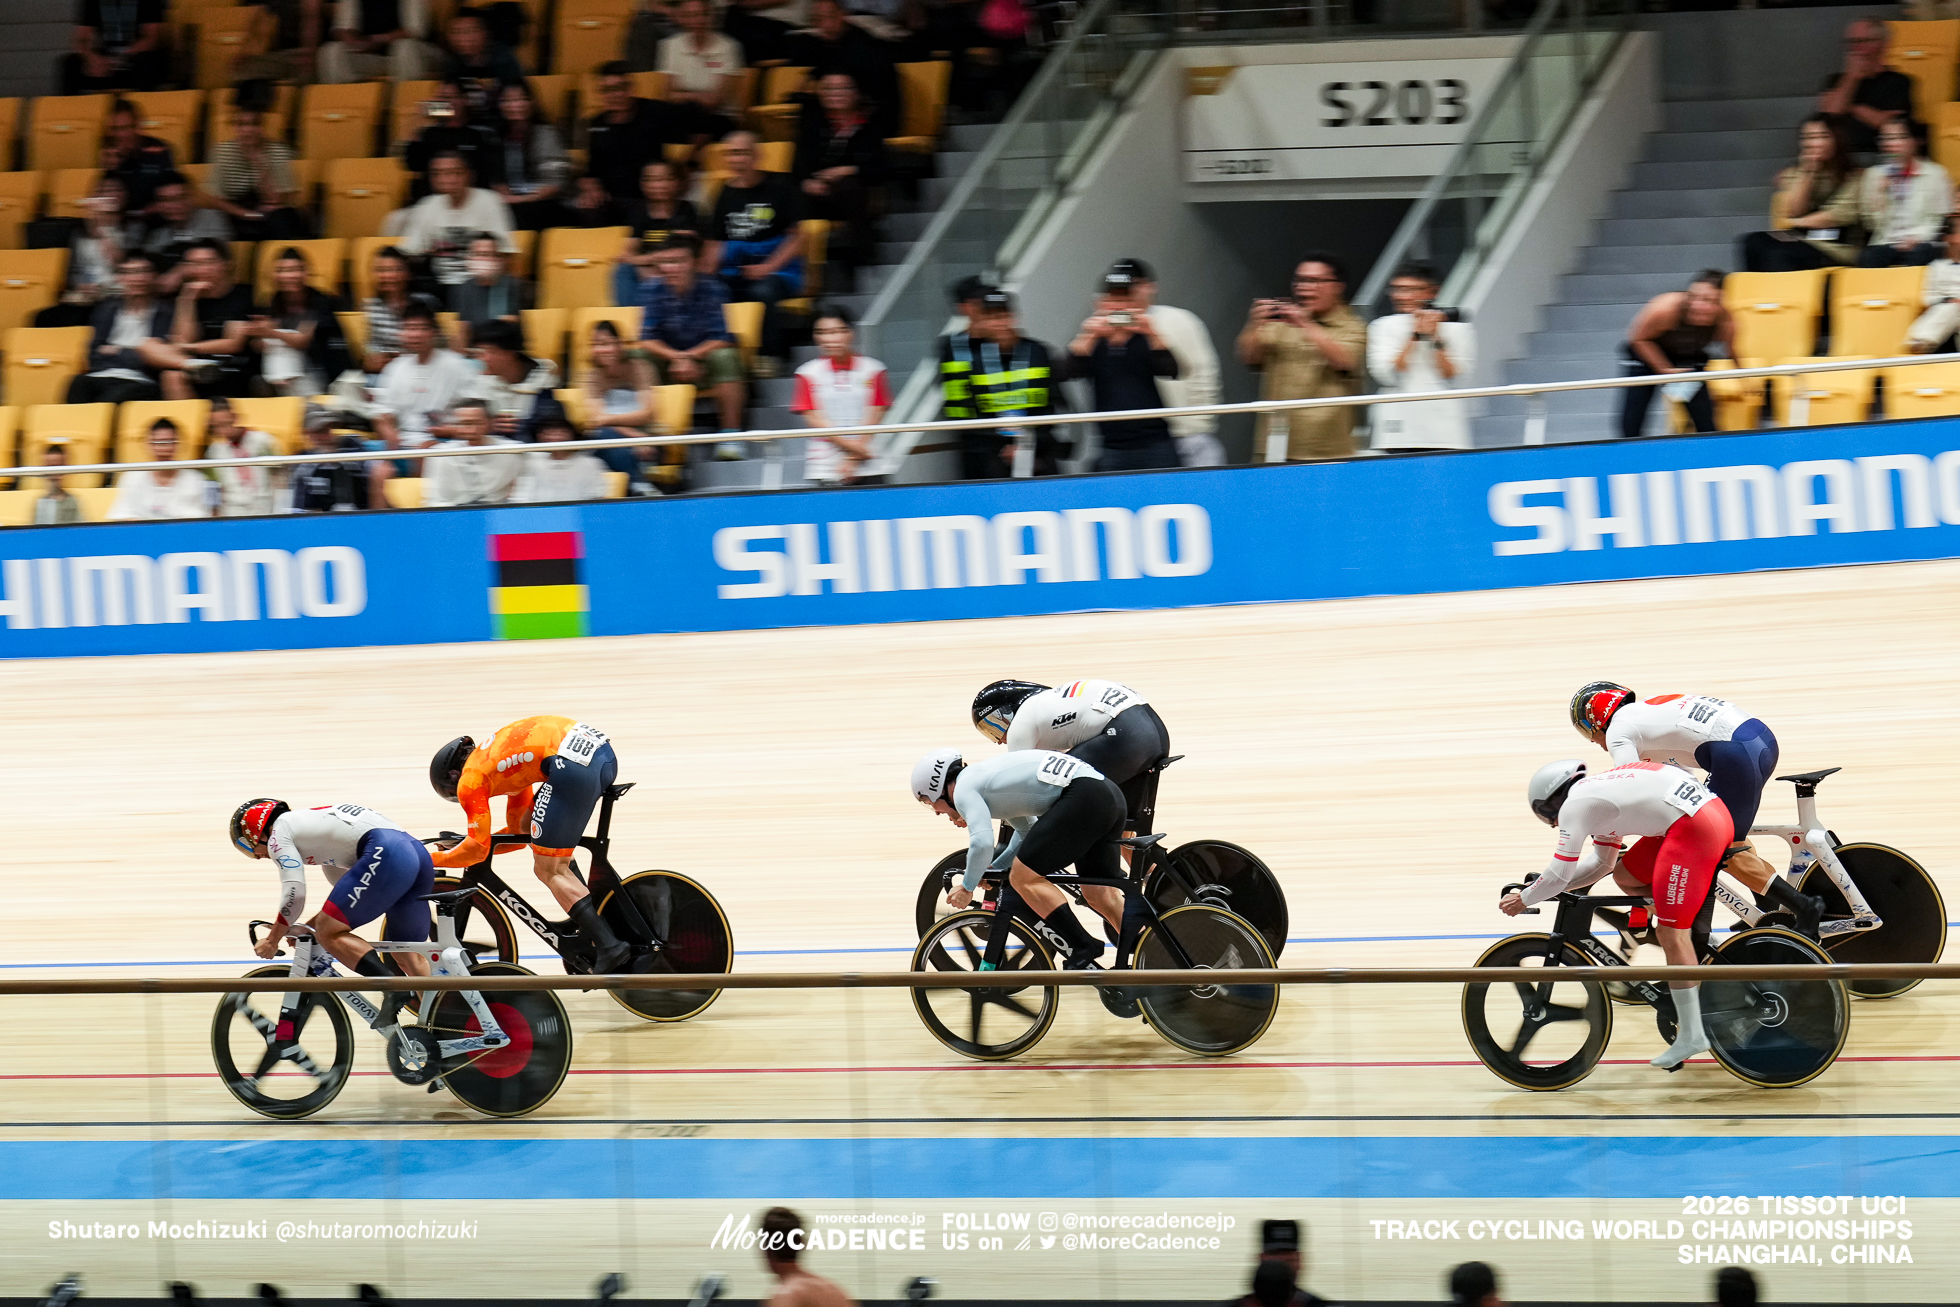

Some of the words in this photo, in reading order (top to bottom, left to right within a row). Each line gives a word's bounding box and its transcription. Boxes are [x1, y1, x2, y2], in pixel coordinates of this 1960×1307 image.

[1320, 78, 1472, 128] S203
[711, 503, 1214, 600] SHIMANO
[1100, 687, 1129, 708] 127
[1051, 711, 1078, 727] KTM
[1687, 702, 1719, 724] 167
[928, 759, 945, 792] KASK
[1042, 755, 1077, 779] 201
[1577, 772, 1635, 786] POLSKA
[1674, 780, 1703, 807] 194
[347, 846, 384, 909] JAPAN
[1714, 886, 1749, 915] RAYCA
[499, 889, 559, 949] KOGA
[346, 991, 376, 1019] TORAY
[1640, 985, 1659, 1002] 18
